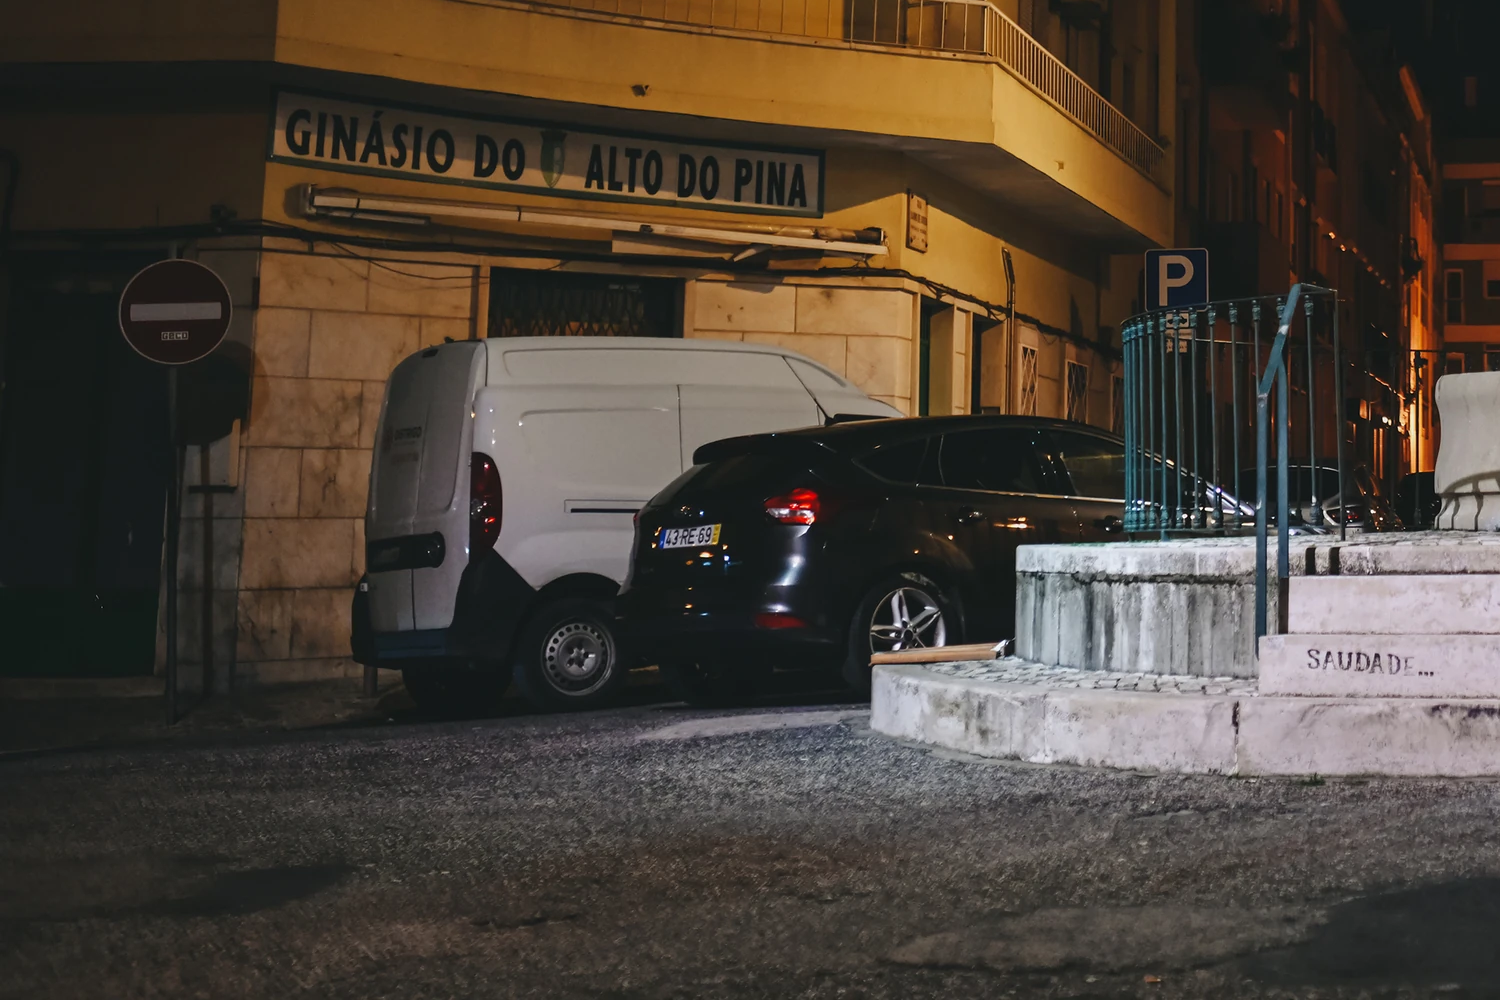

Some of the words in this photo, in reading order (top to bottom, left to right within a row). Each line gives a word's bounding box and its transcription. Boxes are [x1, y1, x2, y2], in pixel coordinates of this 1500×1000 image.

[285, 109, 455, 173] GINÁSIO
[473, 134, 526, 181] DO
[585, 144, 663, 195] ALTO
[677, 153, 720, 200] DO
[733, 158, 808, 208] PINA
[1158, 255, 1195, 307] P
